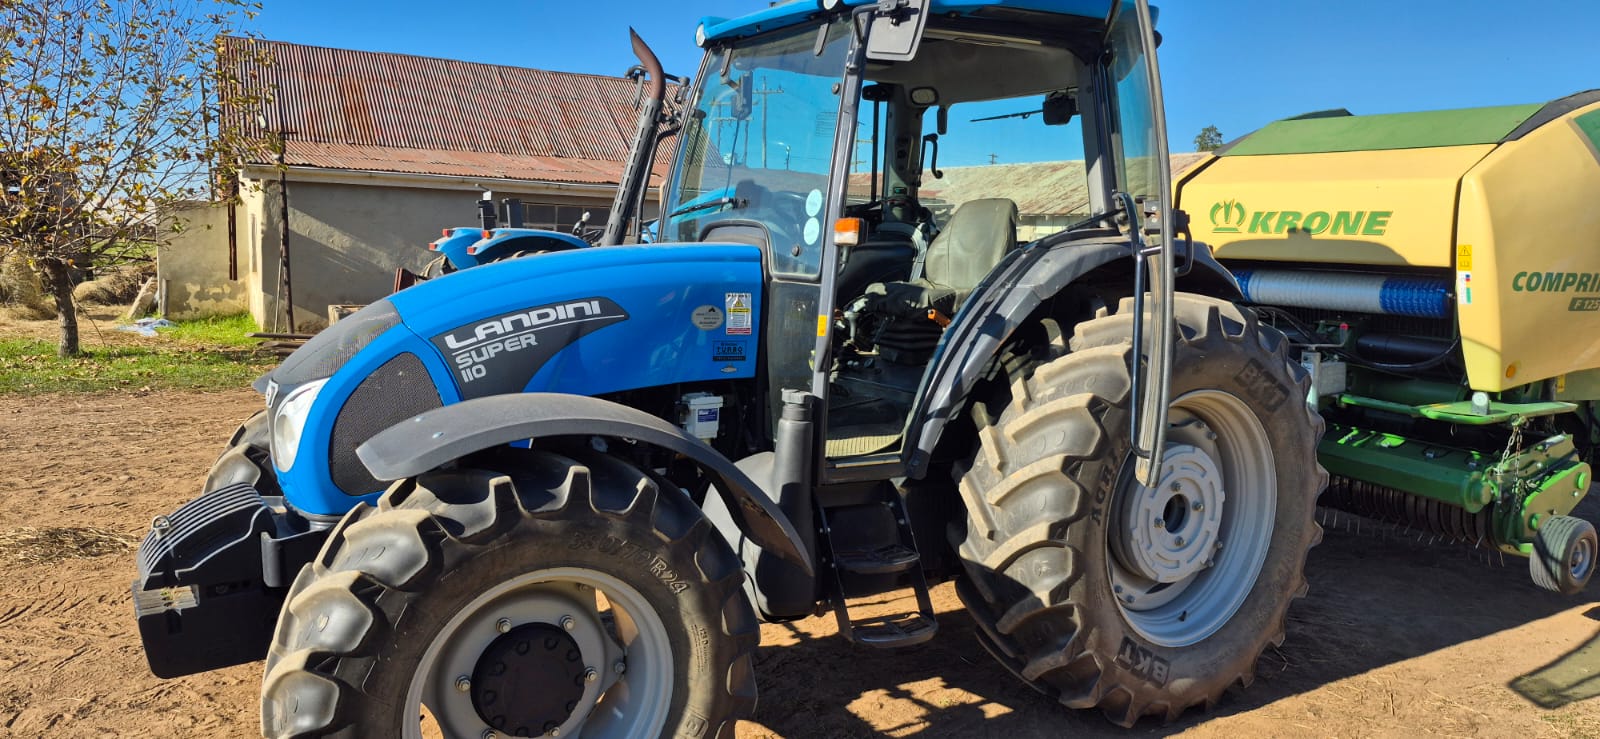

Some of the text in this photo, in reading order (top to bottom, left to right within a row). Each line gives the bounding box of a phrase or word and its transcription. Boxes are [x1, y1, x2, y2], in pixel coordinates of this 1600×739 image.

[1248, 210, 1393, 236] KRONE
[1584, 301, 1600, 309] 125
[444, 300, 601, 349] LANDINI
[455, 333, 538, 369] SUPER
[460, 364, 487, 383] 110
[1118, 636, 1169, 688] BKT
